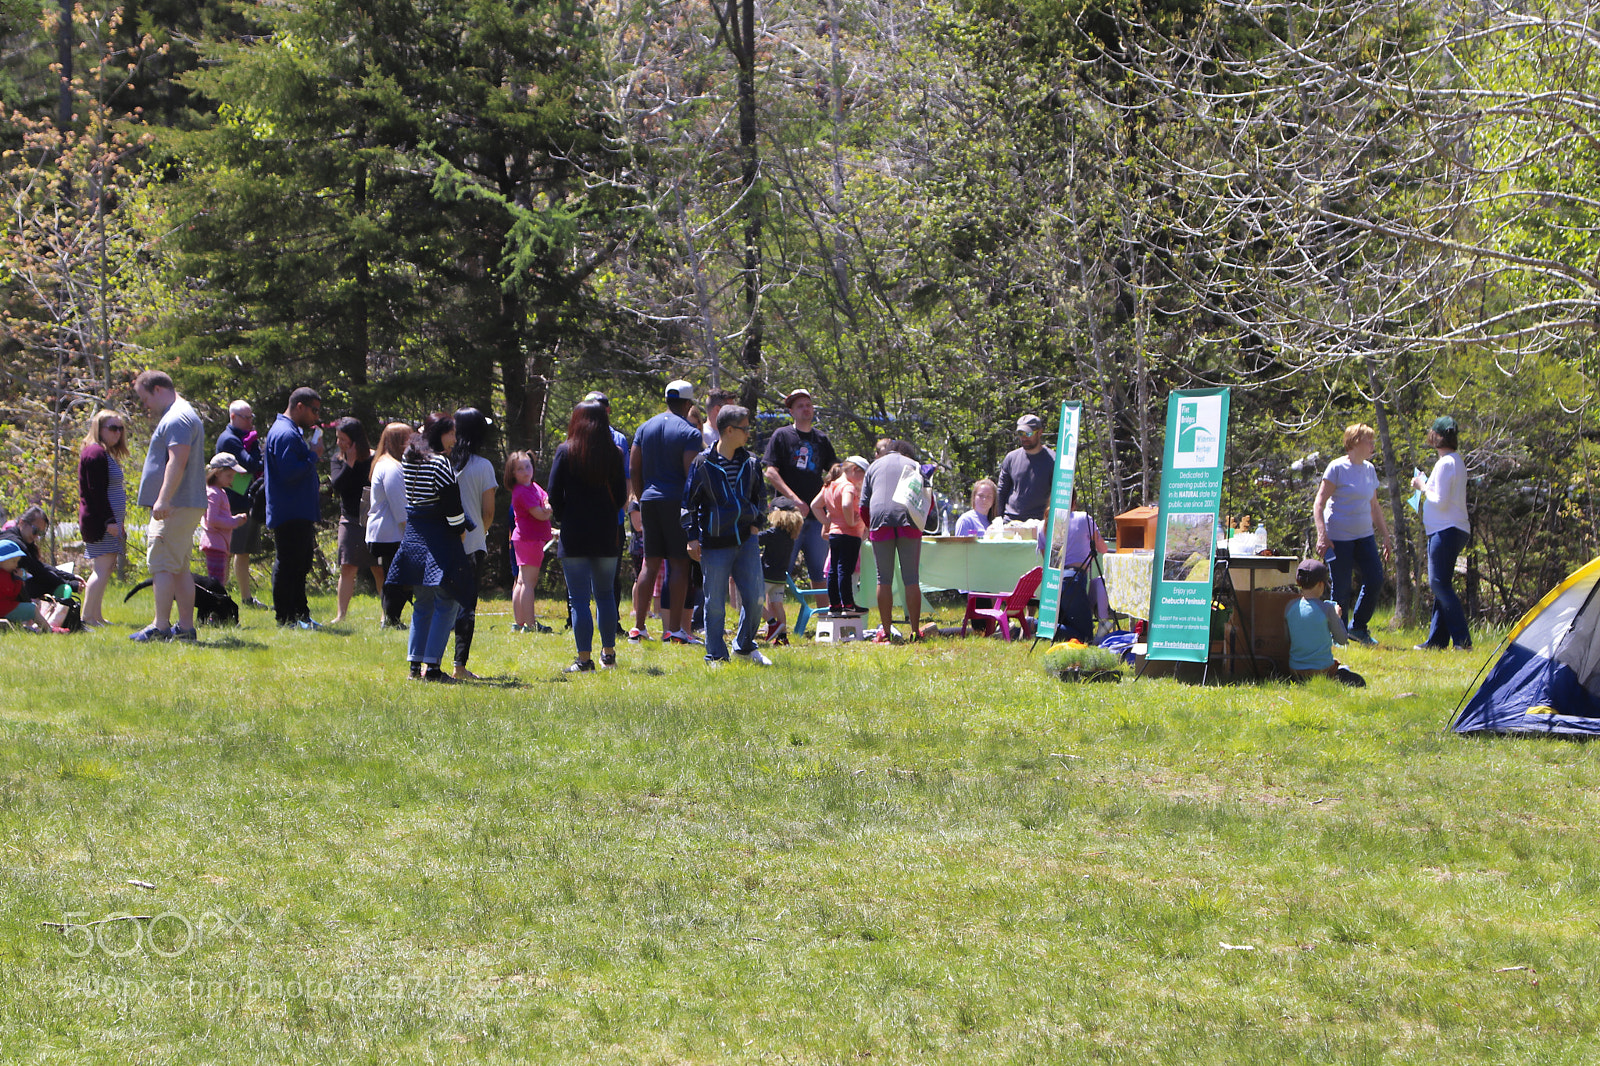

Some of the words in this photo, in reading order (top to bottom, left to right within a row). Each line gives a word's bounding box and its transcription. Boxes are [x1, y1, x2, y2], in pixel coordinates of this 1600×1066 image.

[1179, 471, 1204, 479] Dedicated
[1168, 481, 1193, 489] conserving
[1193, 481, 1207, 489] public
[1208, 480, 1219, 488] land
[1178, 490, 1199, 498] NATURAL
[1199, 490, 1210, 498] state
[1168, 500, 1182, 508] public
[1173, 586, 1185, 596] Enjoy
[1186, 588, 1197, 596] your
[1161, 596, 1185, 605] Chebucto
[1185, 597, 1206, 605] Peninsula
